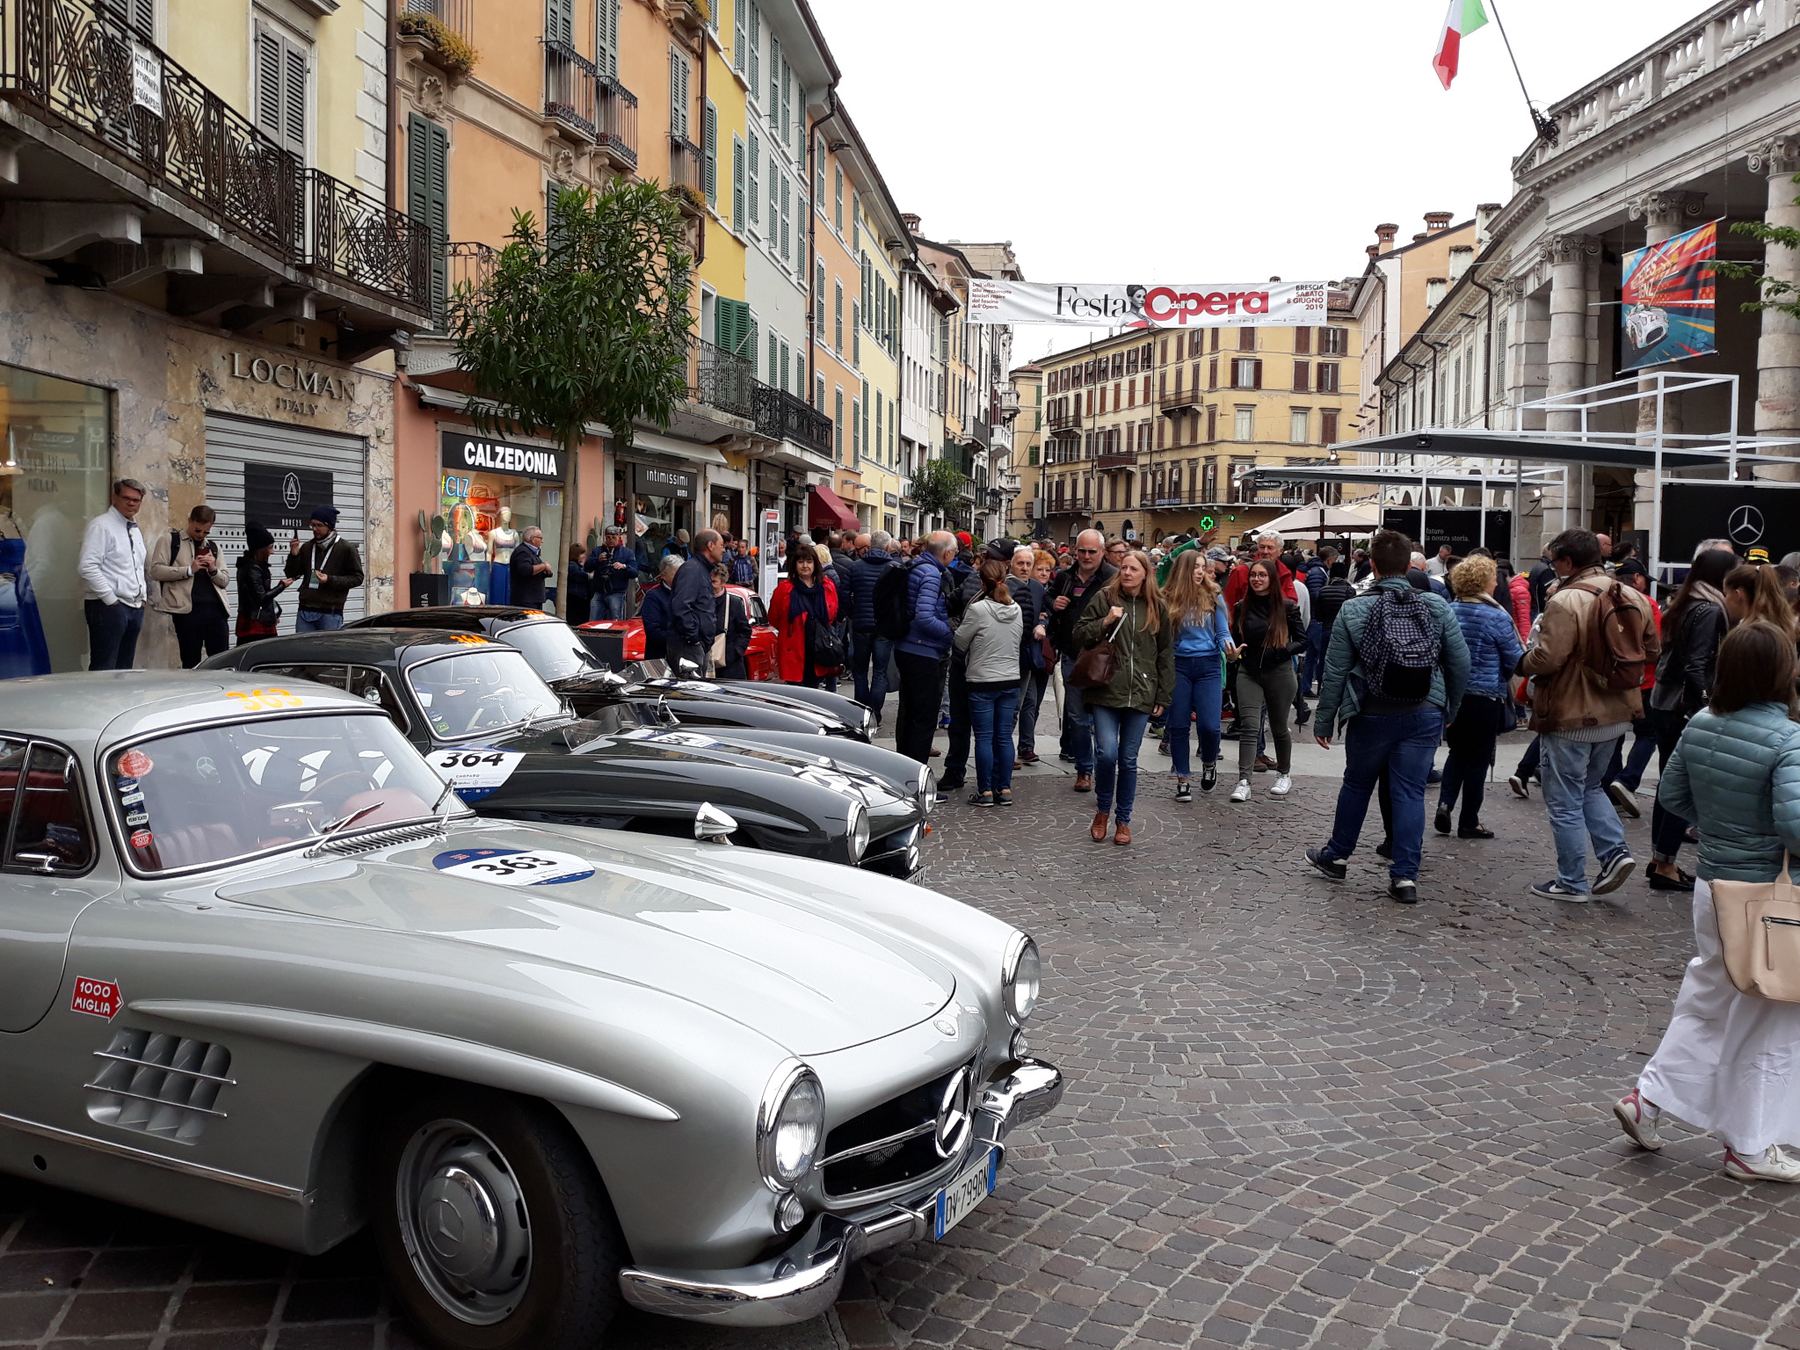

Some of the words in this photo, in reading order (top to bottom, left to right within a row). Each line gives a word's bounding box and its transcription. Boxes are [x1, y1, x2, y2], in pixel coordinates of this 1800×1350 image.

[1052, 286, 1127, 318] Festa
[1143, 286, 1269, 325] Opera
[230, 351, 356, 403] LOCMAN
[276, 397, 318, 416] ITALY
[464, 441, 558, 476] CALZEDONIA
[646, 469, 689, 487] intimissimi
[224, 687, 305, 711] 363
[440, 752, 504, 768] 364
[471, 856, 558, 876] 363
[80, 981, 111, 998] 1000
[74, 996, 111, 1015] MIGLIA
